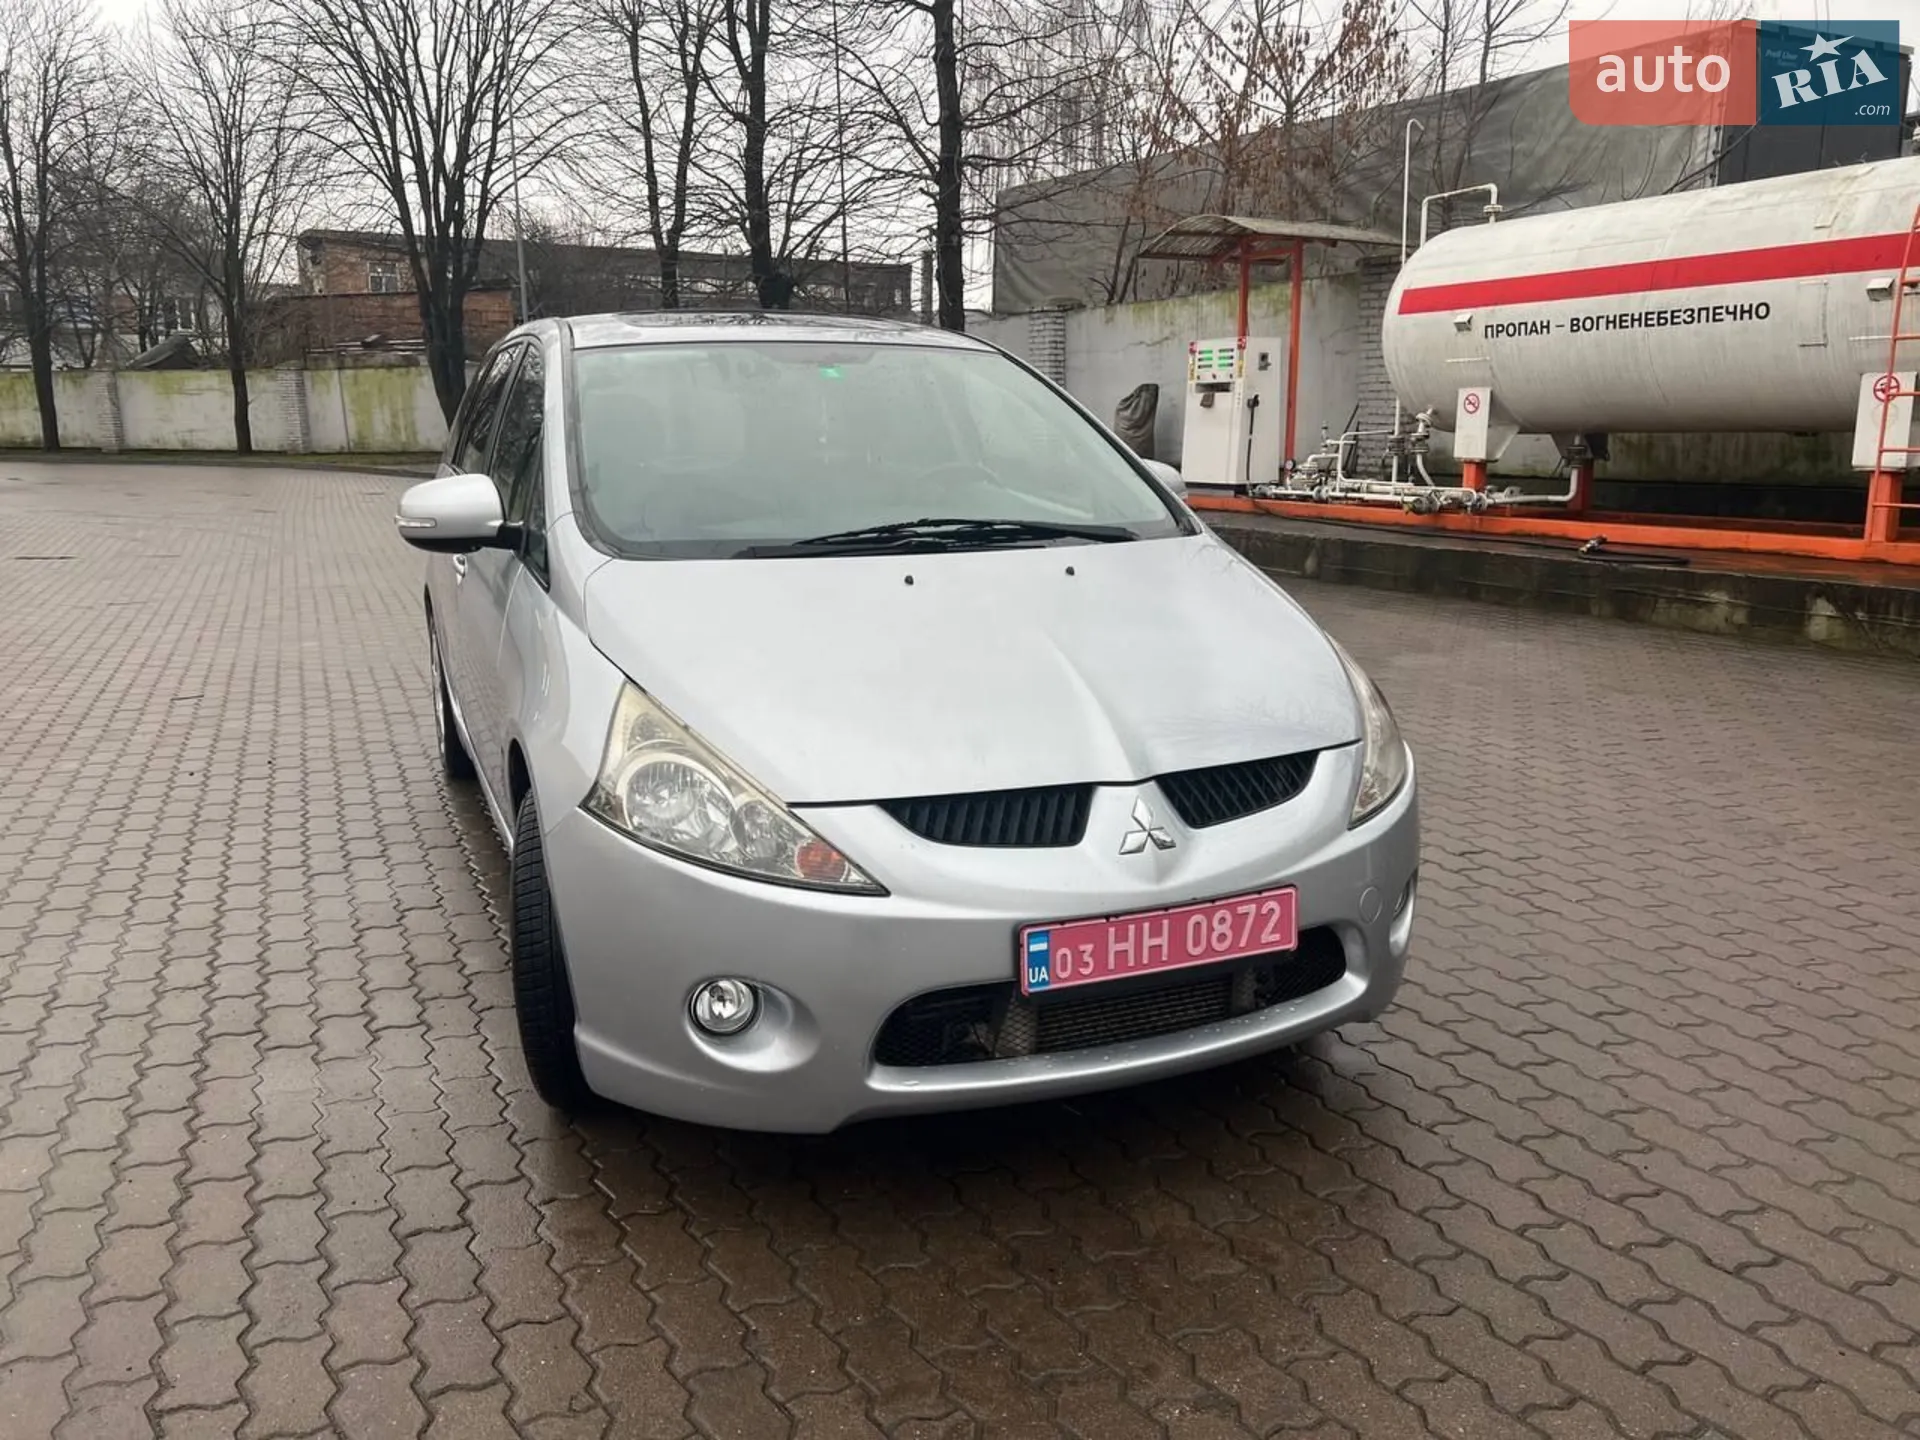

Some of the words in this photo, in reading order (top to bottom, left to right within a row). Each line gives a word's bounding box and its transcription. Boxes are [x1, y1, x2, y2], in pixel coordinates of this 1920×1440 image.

[1484, 318, 1551, 339] ПРОПАН
[1570, 301, 1771, 333] ВОГНЕНЕБЕЗПЕЧНО
[1055, 943, 1095, 979] 03
[1107, 918, 1168, 970] HH
[1186, 900, 1281, 956] 0872
[1028, 966, 1049, 984] UA
